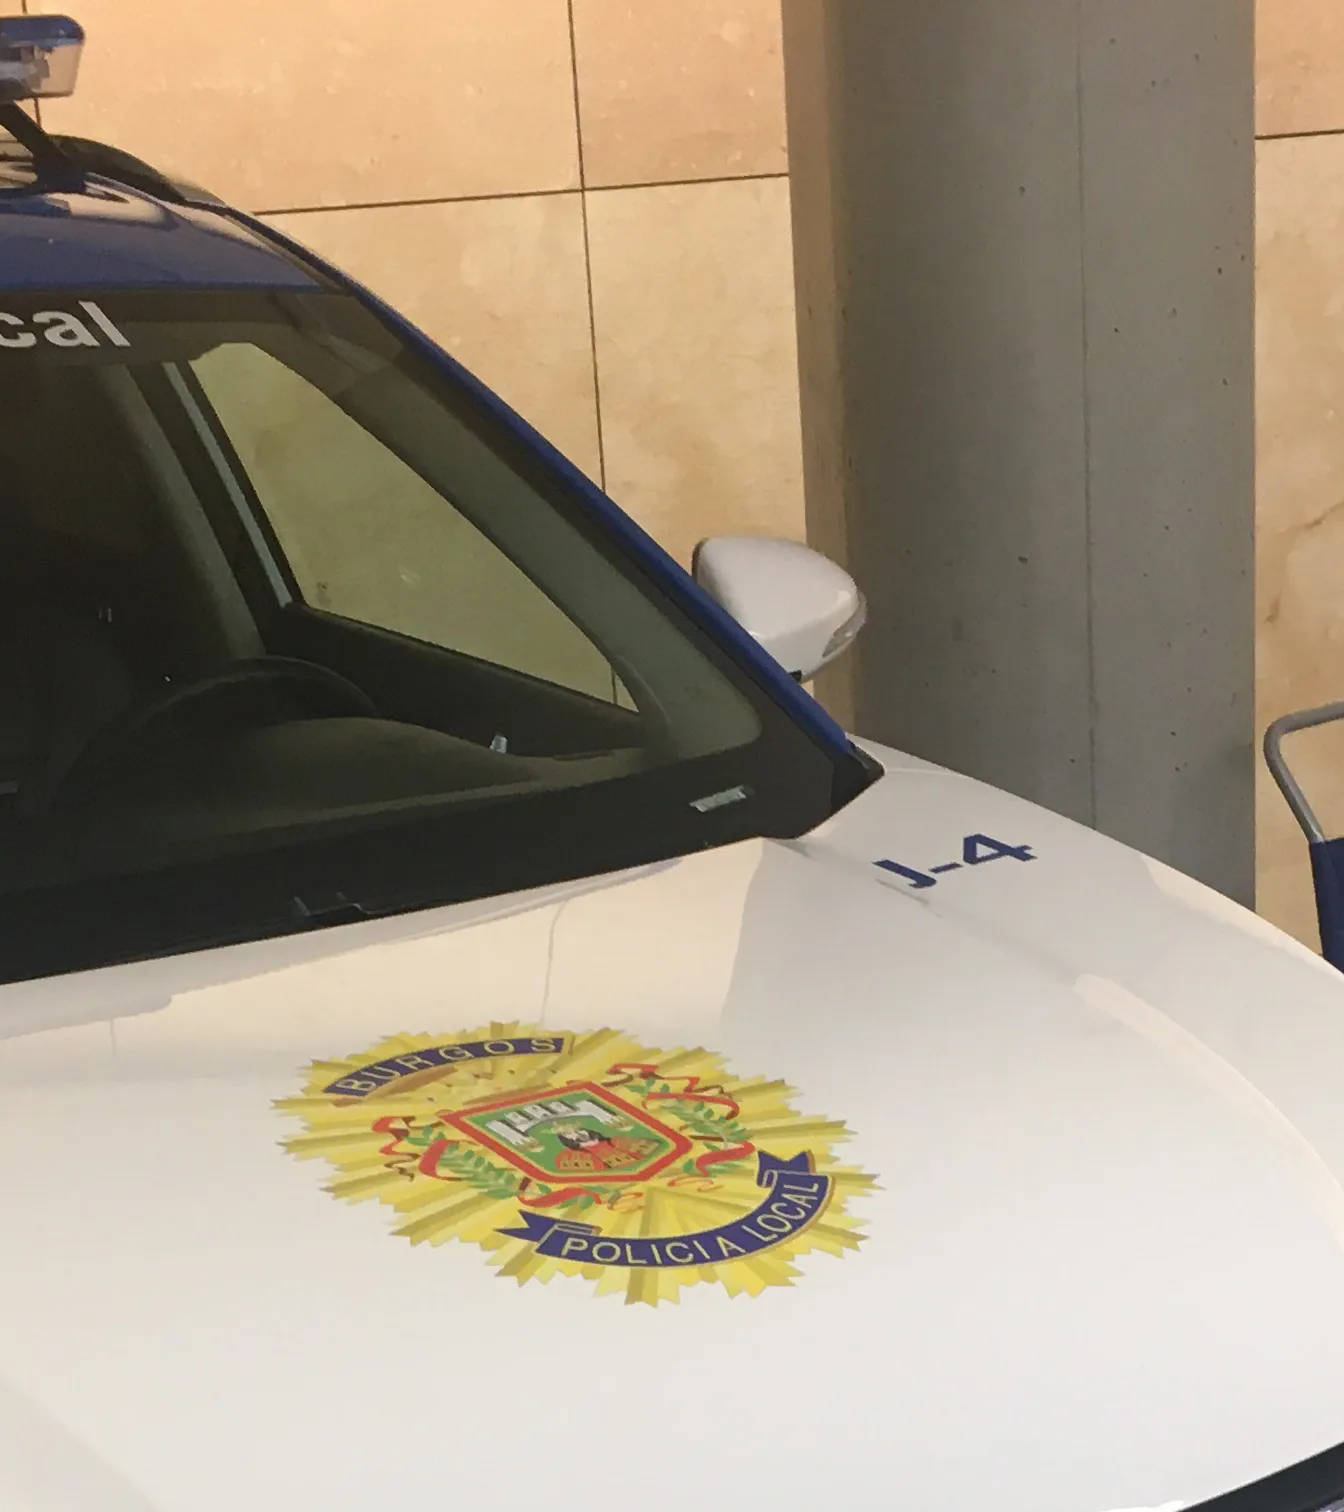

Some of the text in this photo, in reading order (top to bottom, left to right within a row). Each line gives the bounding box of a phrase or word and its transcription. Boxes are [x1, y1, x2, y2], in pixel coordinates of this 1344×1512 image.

[872, 834, 1038, 889] J-4
[335, 1038, 557, 1092] BURGOS
[560, 1182, 819, 1265] POLICIA LOCAL
